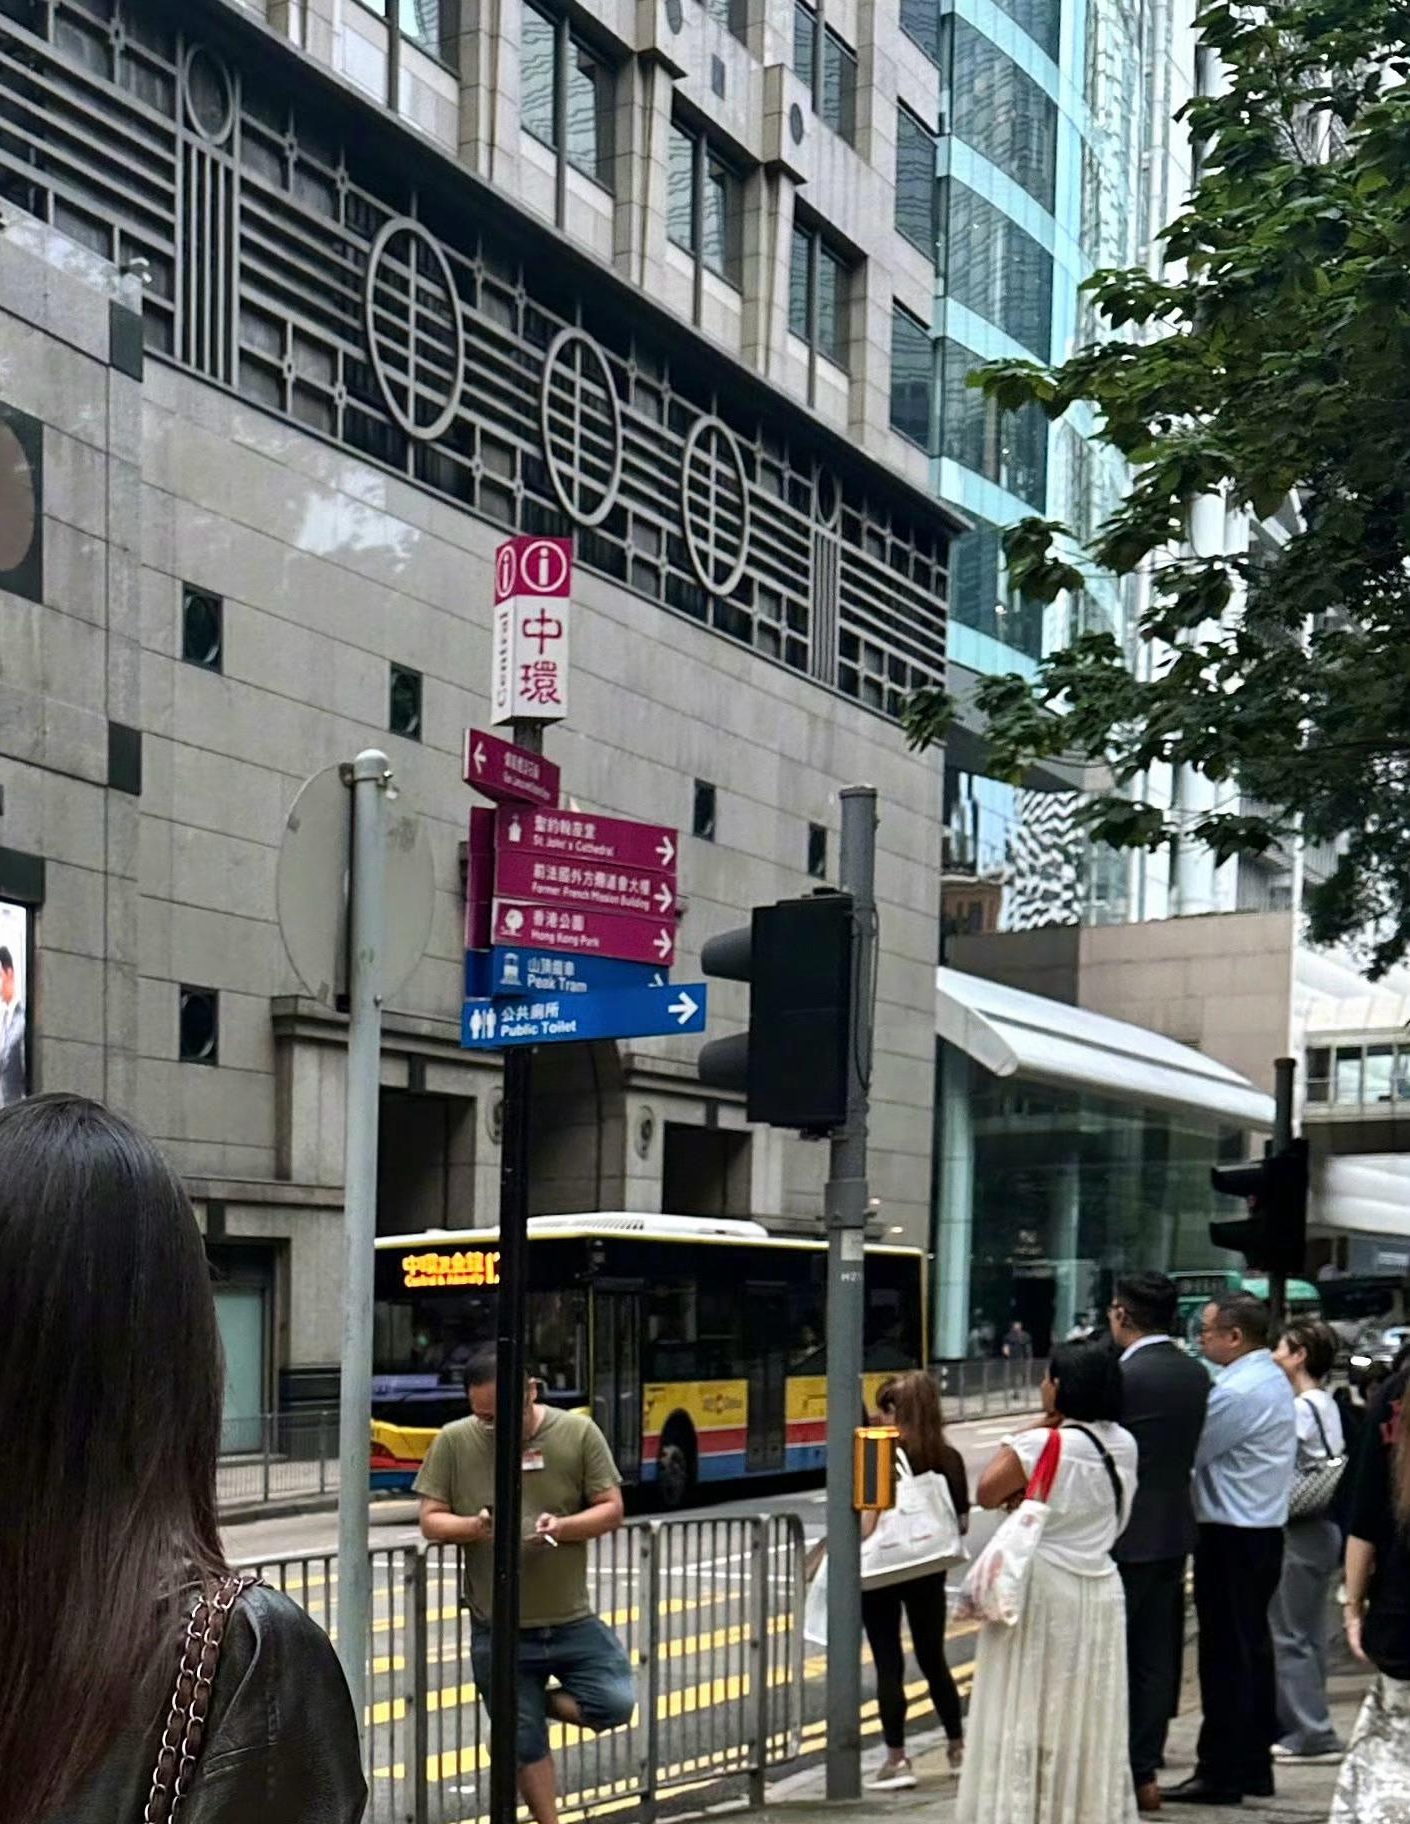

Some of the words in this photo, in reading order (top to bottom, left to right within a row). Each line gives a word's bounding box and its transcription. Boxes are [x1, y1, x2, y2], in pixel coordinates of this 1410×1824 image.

[520, 607, 562, 705] 中環
[574, 840, 614, 857] Cathedral
[532, 881, 561, 896] Former
[562, 886, 590, 900] French
[590, 891, 620, 904] Mission
[620, 894, 650, 912] Building
[533, 909, 585, 931] 香港公園
[531, 929, 555, 944] Hong
[556, 932, 579, 947] Kong
[580, 934, 600, 948] Park
[527, 973, 556, 990] Peak
[558, 976, 588, 993] Tram
[500, 1023, 539, 1038] Public
[541, 1020, 577, 1035] Toilet
